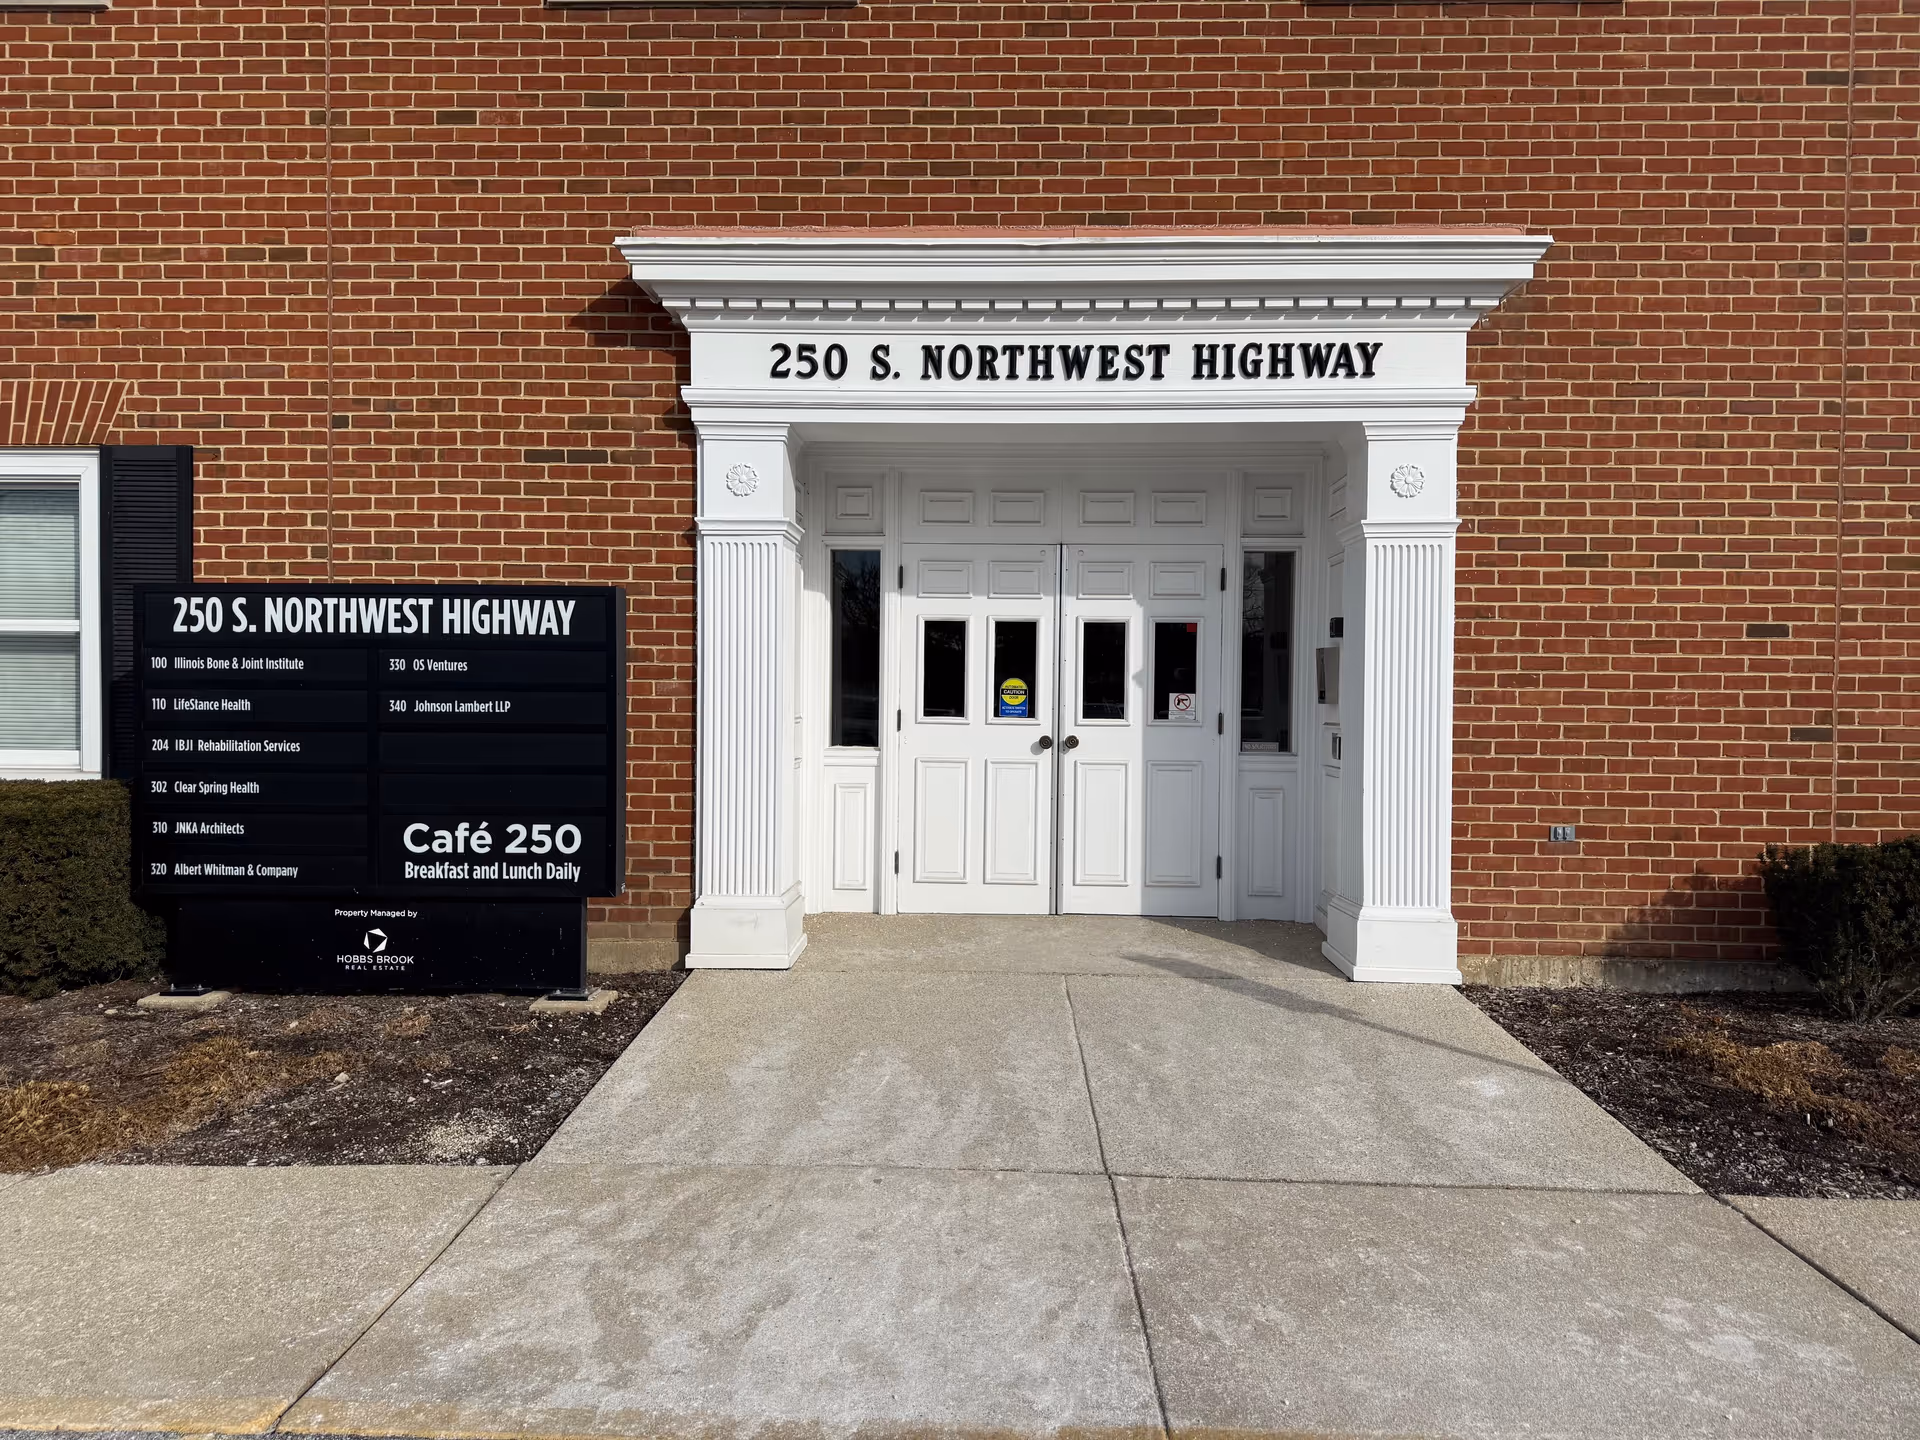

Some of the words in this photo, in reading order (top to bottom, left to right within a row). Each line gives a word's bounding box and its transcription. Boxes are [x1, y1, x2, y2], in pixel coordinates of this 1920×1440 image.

[771, 343, 847, 379] 250
[872, 345, 900, 380] S.
[921, 344, 1170, 381] NORTHWEST
[1193, 343, 1383, 379] HIGHWAY
[173, 597, 223, 632] 250
[232, 597, 256, 632] S.
[265, 597, 433, 633] NORTHWEST
[443, 599, 575, 635] HIGHWAY
[151, 657, 167, 668] 100
[175, 657, 204, 669] Illinois
[207, 657, 229, 669] Bone
[232, 657, 238, 669] &
[241, 658, 263, 669] Joint
[266, 658, 304, 669] Institute
[390, 659, 405, 670] 330
[413, 659, 424, 670] OS
[427, 659, 467, 671] Ventures
[152, 698, 166, 709] 110
[174, 699, 219, 710] LifeStance
[222, 699, 250, 710] Health
[390, 700, 406, 711] 340
[414, 700, 452, 712] Johnson
[455, 701, 493, 712] Lambert
[496, 701, 510, 712] LLP
[152, 739, 169, 750] 204
[176, 739, 193, 751] IBJI
[198, 740, 261, 751] Rehabilitation
[264, 740, 300, 752] Services
[151, 781, 167, 792] 302
[175, 781, 196, 792] Clear
[199, 781, 227, 795] Spring
[230, 782, 259, 793] Health
[153, 822, 167, 833] 310
[175, 822, 198, 833] JNKA
[200, 822, 244, 834] Architects
[404, 821, 492, 853] Café
[505, 824, 581, 854] 250
[151, 863, 166, 875] 320
[175, 864, 201, 875] Albert
[204, 864, 245, 875] Whitman
[247, 864, 254, 875] &
[257, 864, 298, 878] Company
[405, 862, 469, 879] Breakfast
[473, 862, 498, 879] and
[503, 862, 542, 879] Lunch
[547, 863, 580, 882] Daily
[335, 909, 368, 917] Property
[371, 910, 405, 918] Managed
[408, 910, 417, 918] by
[337, 955, 373, 963] HOBBS
[377, 955, 414, 964] BROOK
